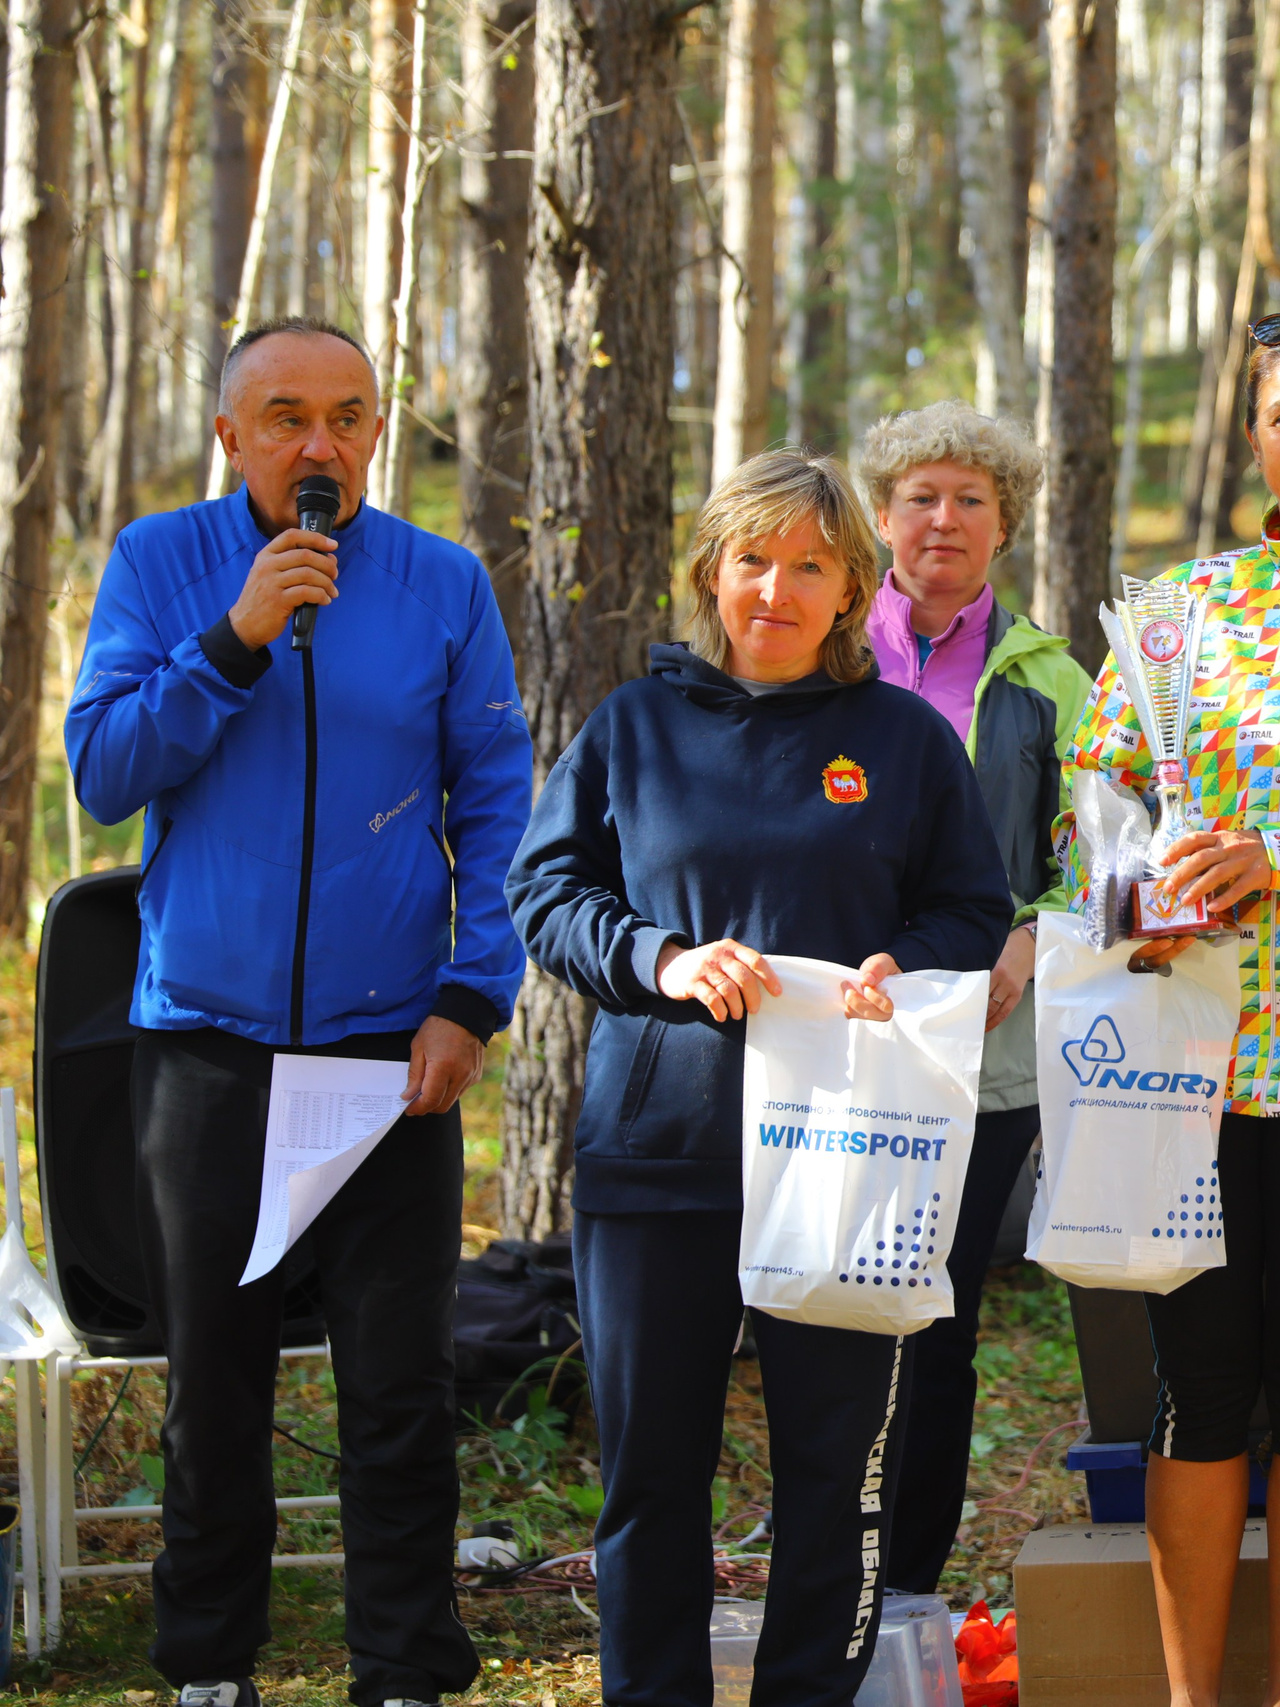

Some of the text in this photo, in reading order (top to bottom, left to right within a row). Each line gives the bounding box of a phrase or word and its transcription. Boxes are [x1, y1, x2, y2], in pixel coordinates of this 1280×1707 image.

[386, 788, 419, 821] NORD
[1097, 1068, 1218, 1099] NORD
[827, 1106, 912, 1122] ЭИРОВОЧНЫЙ
[1150, 1102, 1199, 1113] СПОРТИВНАЯ
[759, 1123, 947, 1161] WINTERSPORT
[1051, 1222, 1123, 1235] wintersport45.ru
[846, 1335, 904, 1659] ЕЛЯБИНСКАЯ ОБЛАСТЬ
